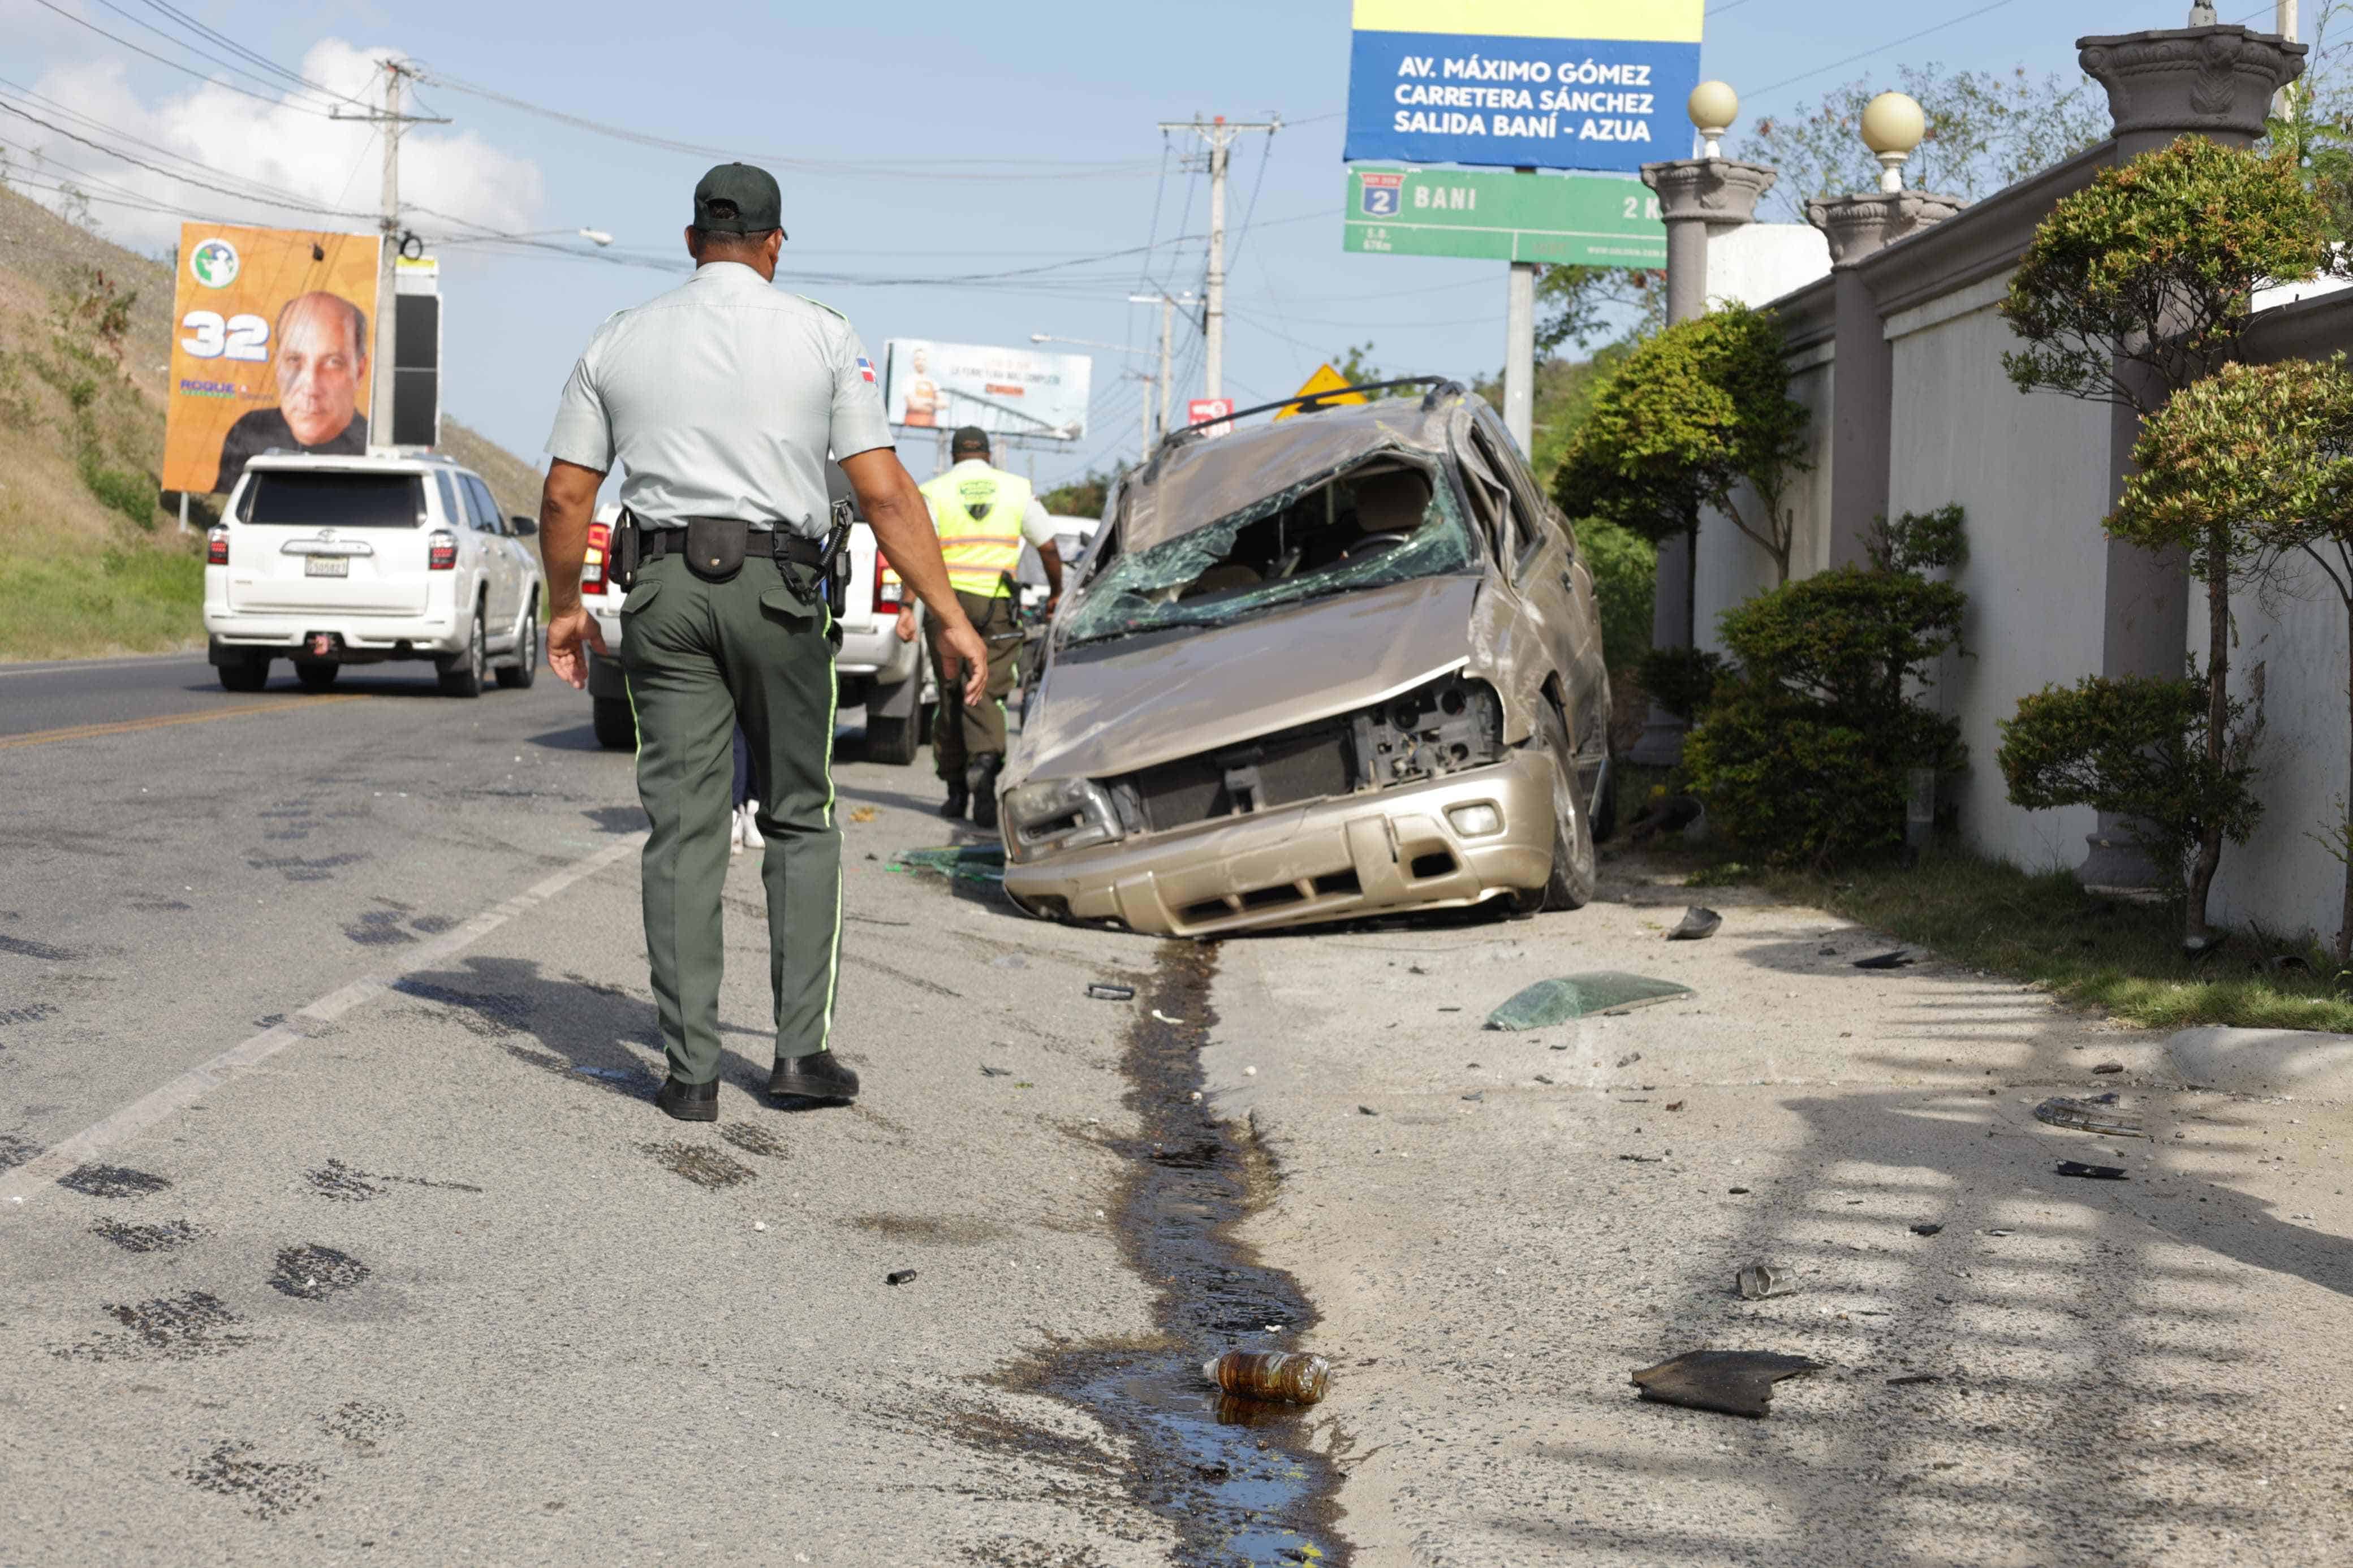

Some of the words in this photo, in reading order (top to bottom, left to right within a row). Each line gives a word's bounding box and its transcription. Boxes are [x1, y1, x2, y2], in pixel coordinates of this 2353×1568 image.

[1398, 56, 1436, 77] AV.
[1443, 54, 1552, 83] MÁXIMO
[1557, 58, 1651, 86] GÓMEZ
[1394, 84, 1534, 110] CARRETERA
[1539, 85, 1654, 114] SÁNCHEZ
[1393, 110, 1487, 136] SALIDA
[1492, 111, 1558, 138] BANÍ
[1578, 118, 1652, 142] AZUA
[1371, 190, 1391, 213] 2
[1413, 184, 1477, 211] BANI
[1622, 195, 1640, 219] 2
[1644, 196, 1664, 221] K
[179, 309, 271, 363] 32
[179, 379, 235, 395] ROQUE
